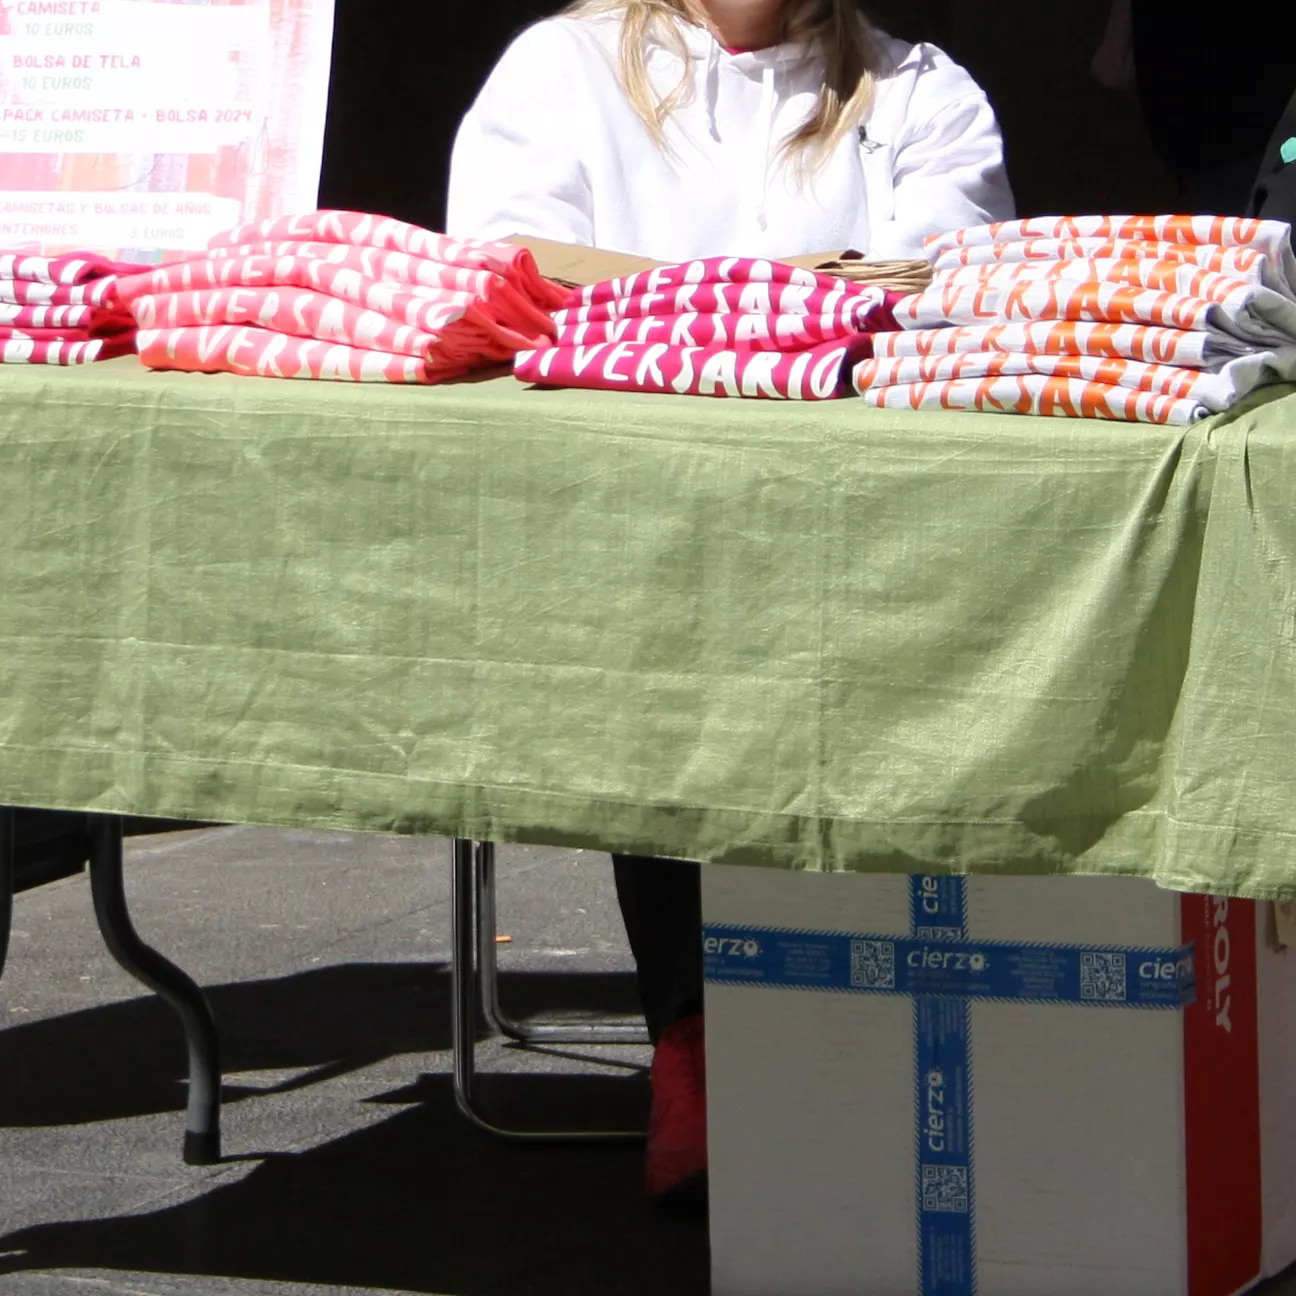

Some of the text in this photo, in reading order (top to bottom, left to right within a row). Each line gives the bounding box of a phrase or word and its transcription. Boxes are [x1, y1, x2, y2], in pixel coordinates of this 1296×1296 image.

[17, 0, 101, 15] CAMISETA
[25, 22, 94, 36] 10 EUROS
[12, 54, 141, 69] BOLSA DE TELA
[21, 76, 92, 91] 10 EUROS
[3, 108, 44, 123] PACK
[51, 108, 135, 123] CAMISETA
[155, 107, 208, 123] BOLSA
[214, 107, 253, 122] 2024
[11, 128, 85, 143] 15 EUROS
[94, 201, 148, 215] BOLSAS
[153, 201, 169, 215] DE
[175, 199, 212, 215] AÑOS
[142, 226, 185, 239] EUROS
[906, 946, 988, 973] cierzo
[923, 1067, 949, 1151] cierzo
